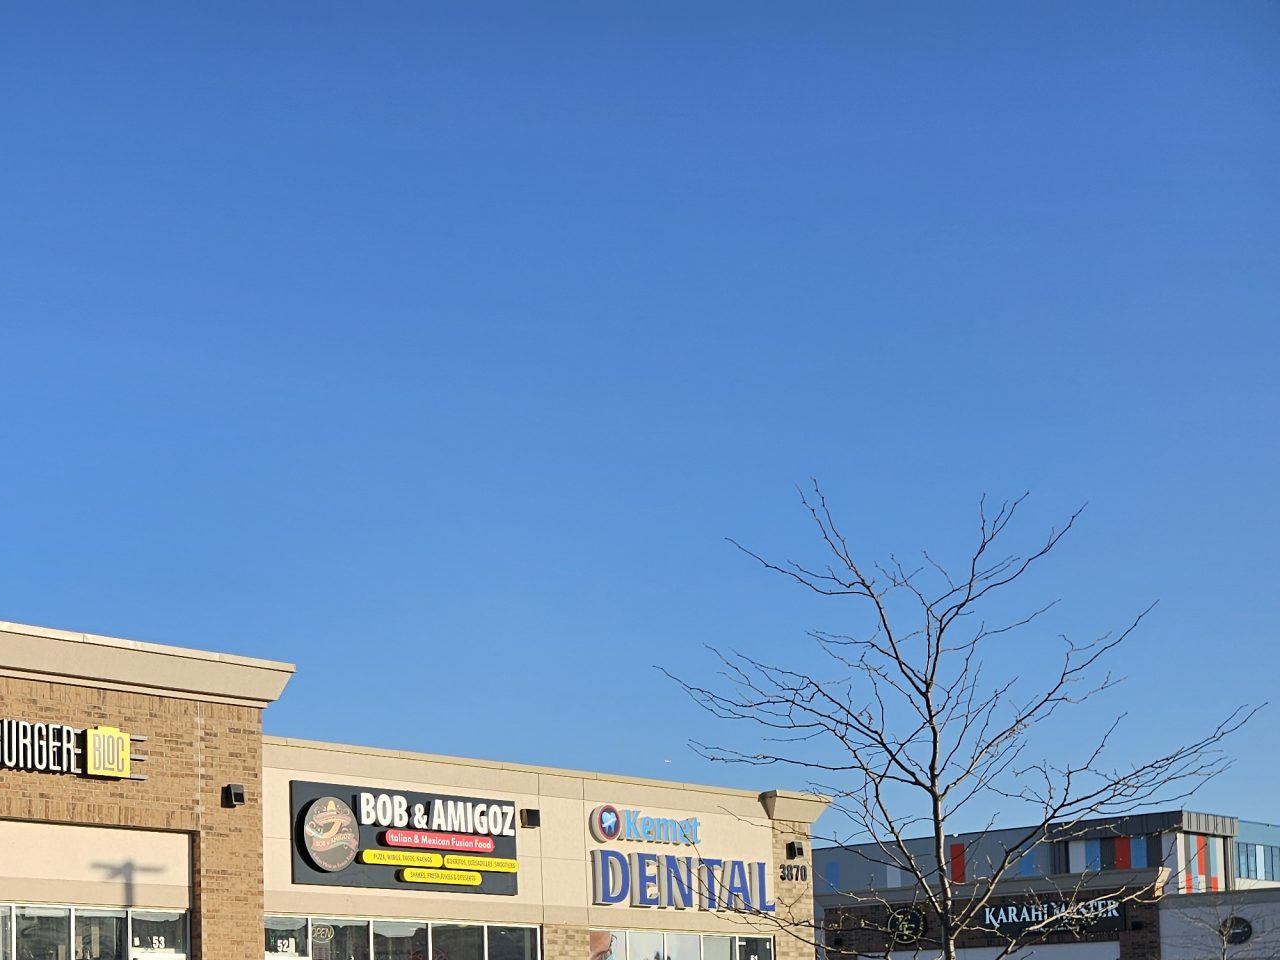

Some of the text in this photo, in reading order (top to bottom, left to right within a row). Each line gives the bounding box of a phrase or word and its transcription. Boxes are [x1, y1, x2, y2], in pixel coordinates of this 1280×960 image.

[93, 733, 125, 773] BLOC
[360, 792, 516, 836] BOB & AMIGOZ
[624, 809, 701, 845] Kemet
[388, 832, 491, 849] Italian & Mexican Fusion Food
[598, 850, 776, 912] DENTAL
[779, 863, 808, 882] 3870
[984, 900, 1120, 928] KARAHI MSTER
[152, 935, 166, 949] 53
[277, 939, 289, 951] 52
